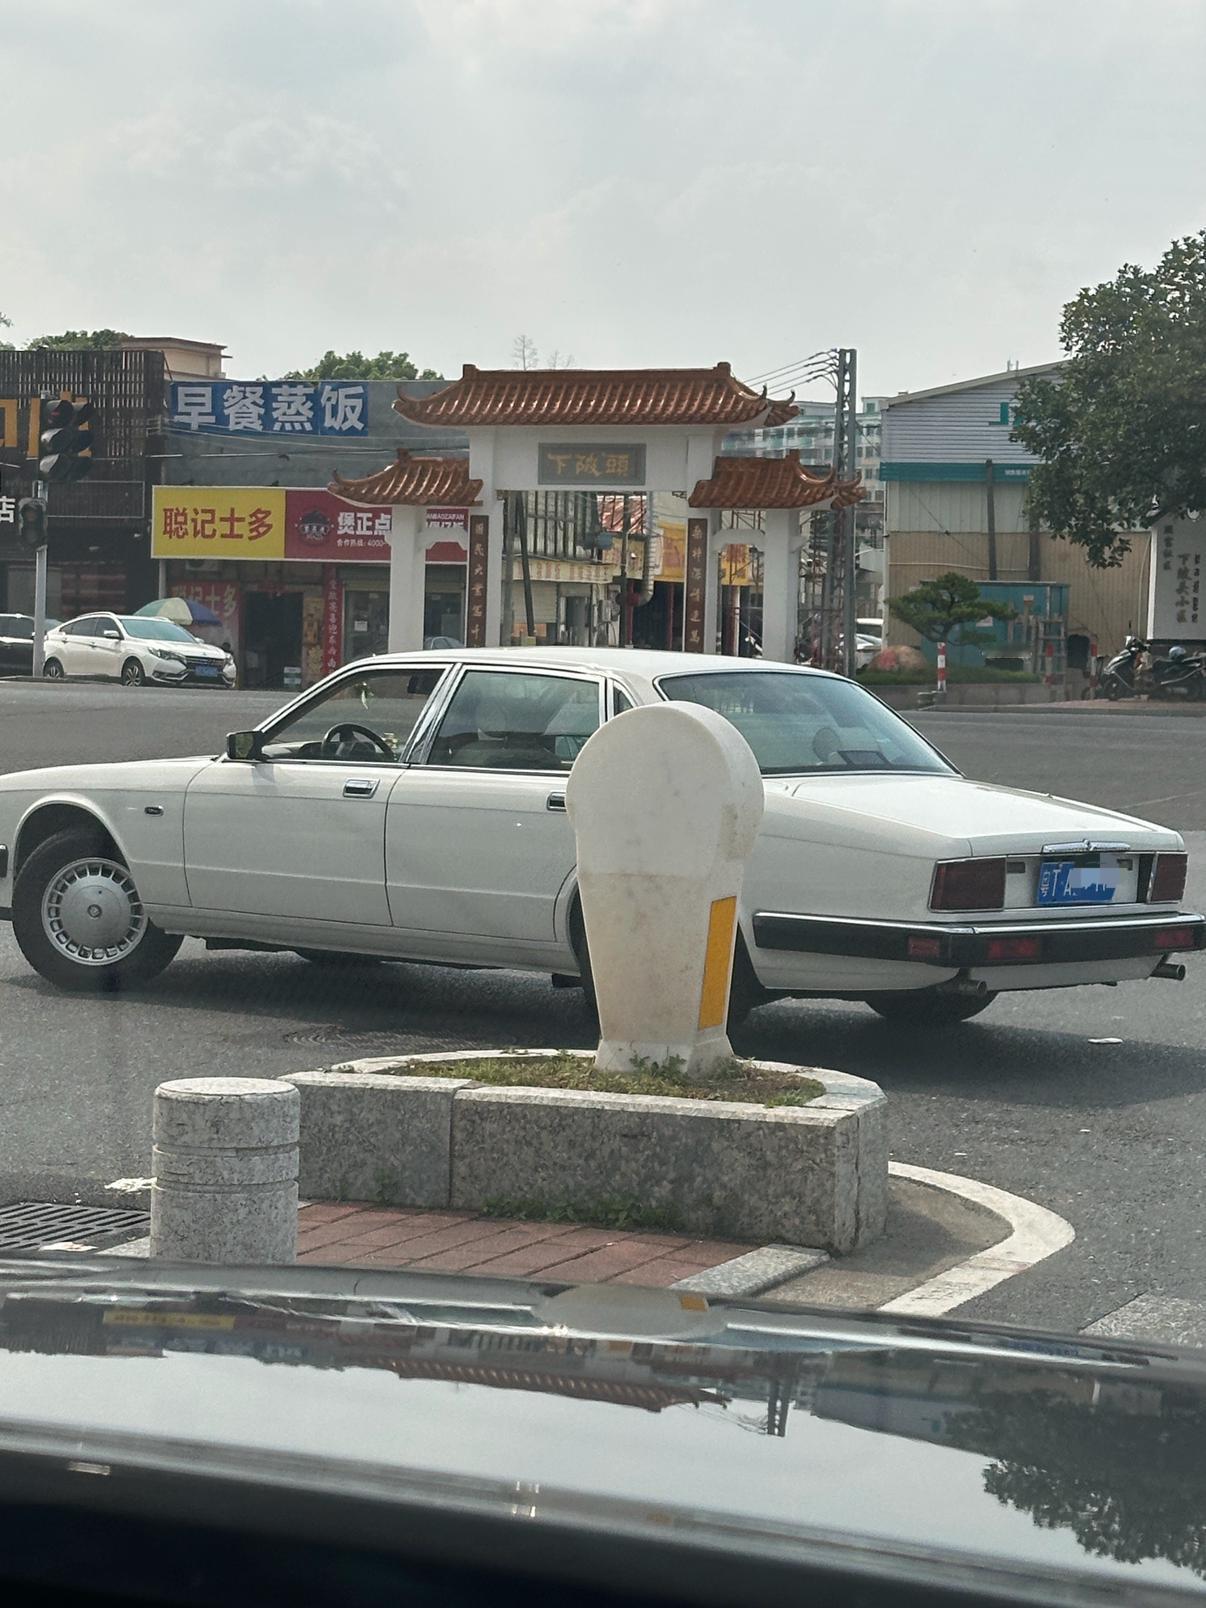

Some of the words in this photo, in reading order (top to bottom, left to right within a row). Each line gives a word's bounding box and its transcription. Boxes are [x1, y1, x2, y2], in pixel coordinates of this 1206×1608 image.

[173, 384, 366, 431] 早餐蒸饭
[162, 507, 273, 540] 聪记士多
